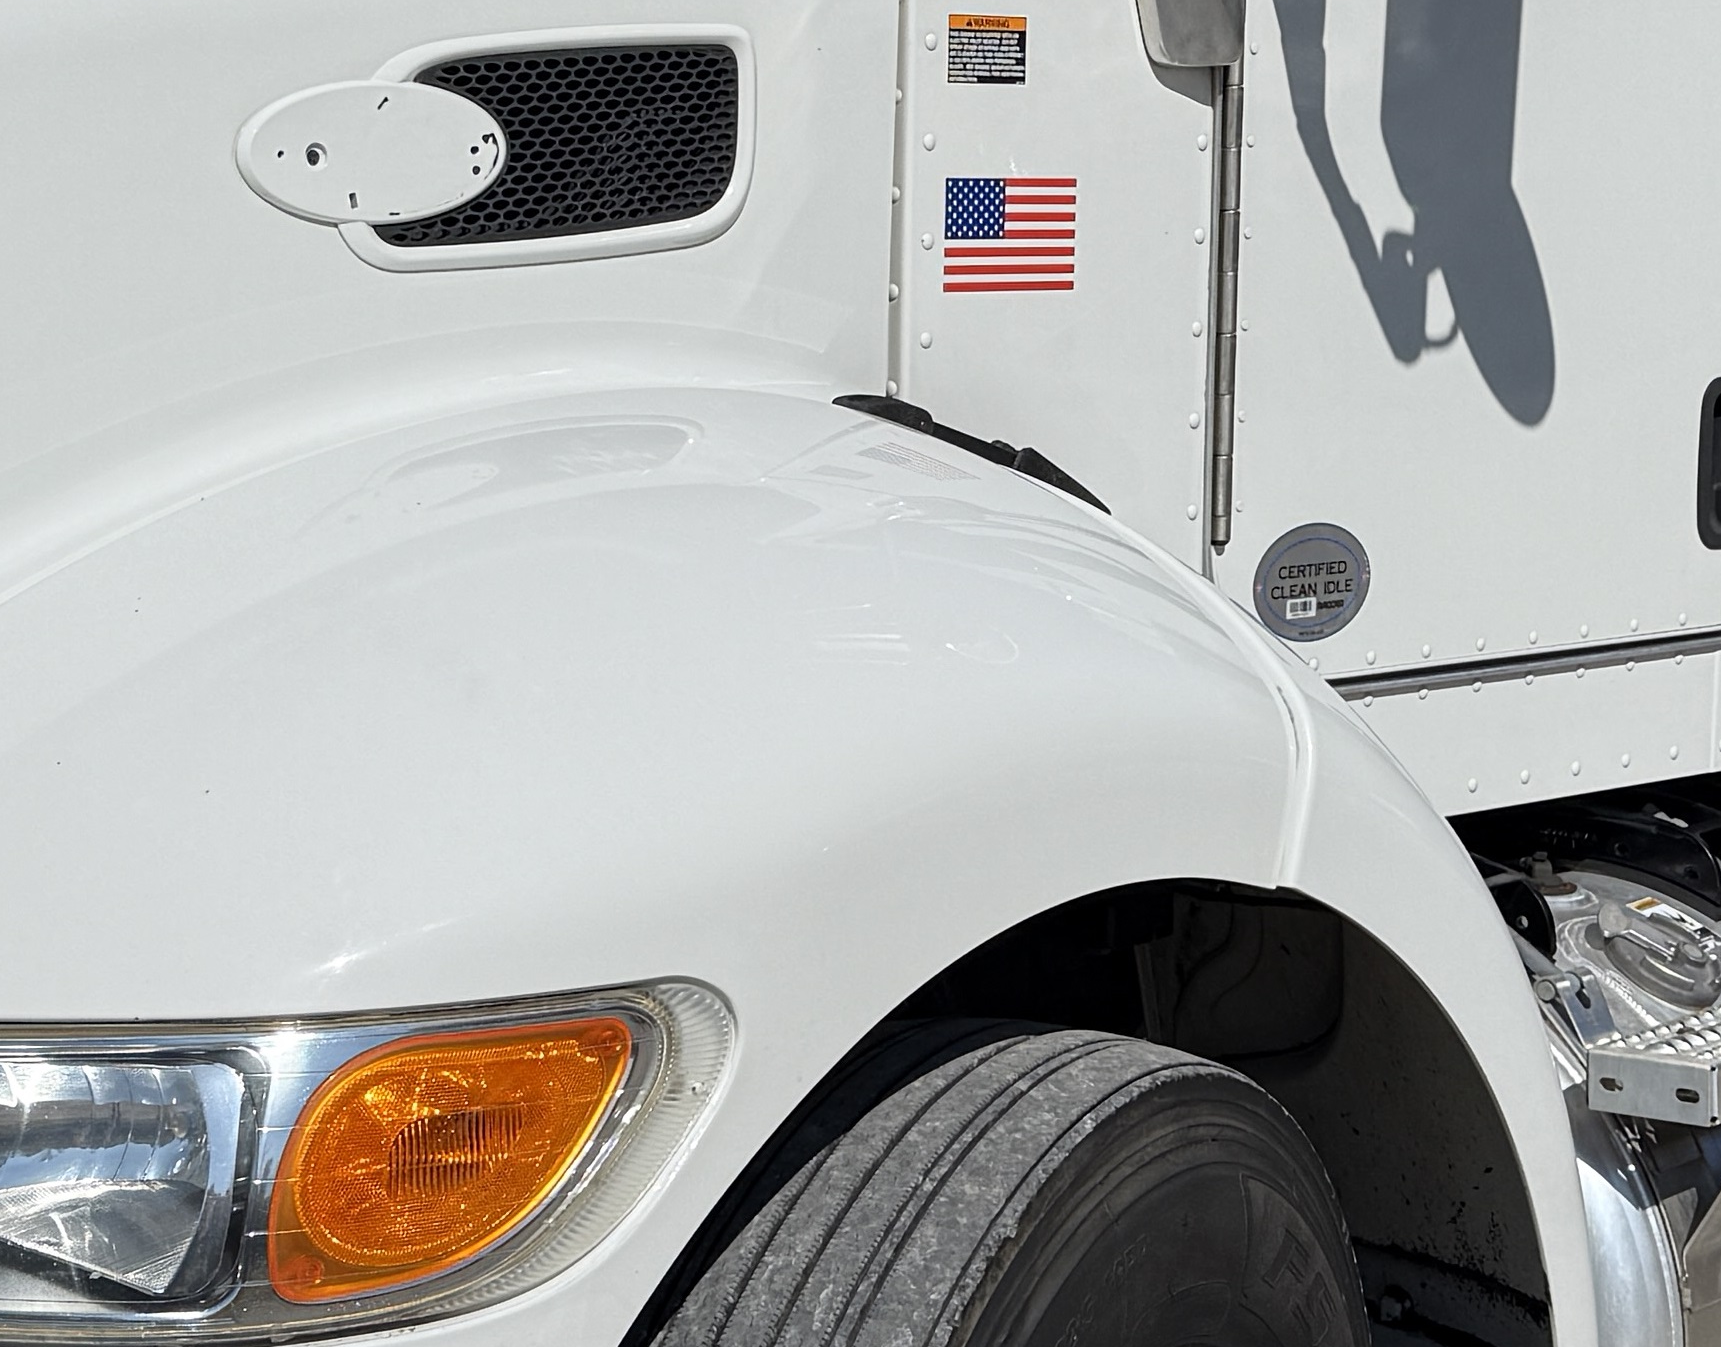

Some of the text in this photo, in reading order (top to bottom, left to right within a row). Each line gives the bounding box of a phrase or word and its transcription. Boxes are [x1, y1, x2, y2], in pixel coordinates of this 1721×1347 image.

[1278, 560, 1347, 580] CERTIFIED
[1270, 578, 1354, 600] CLEAN IDLE
